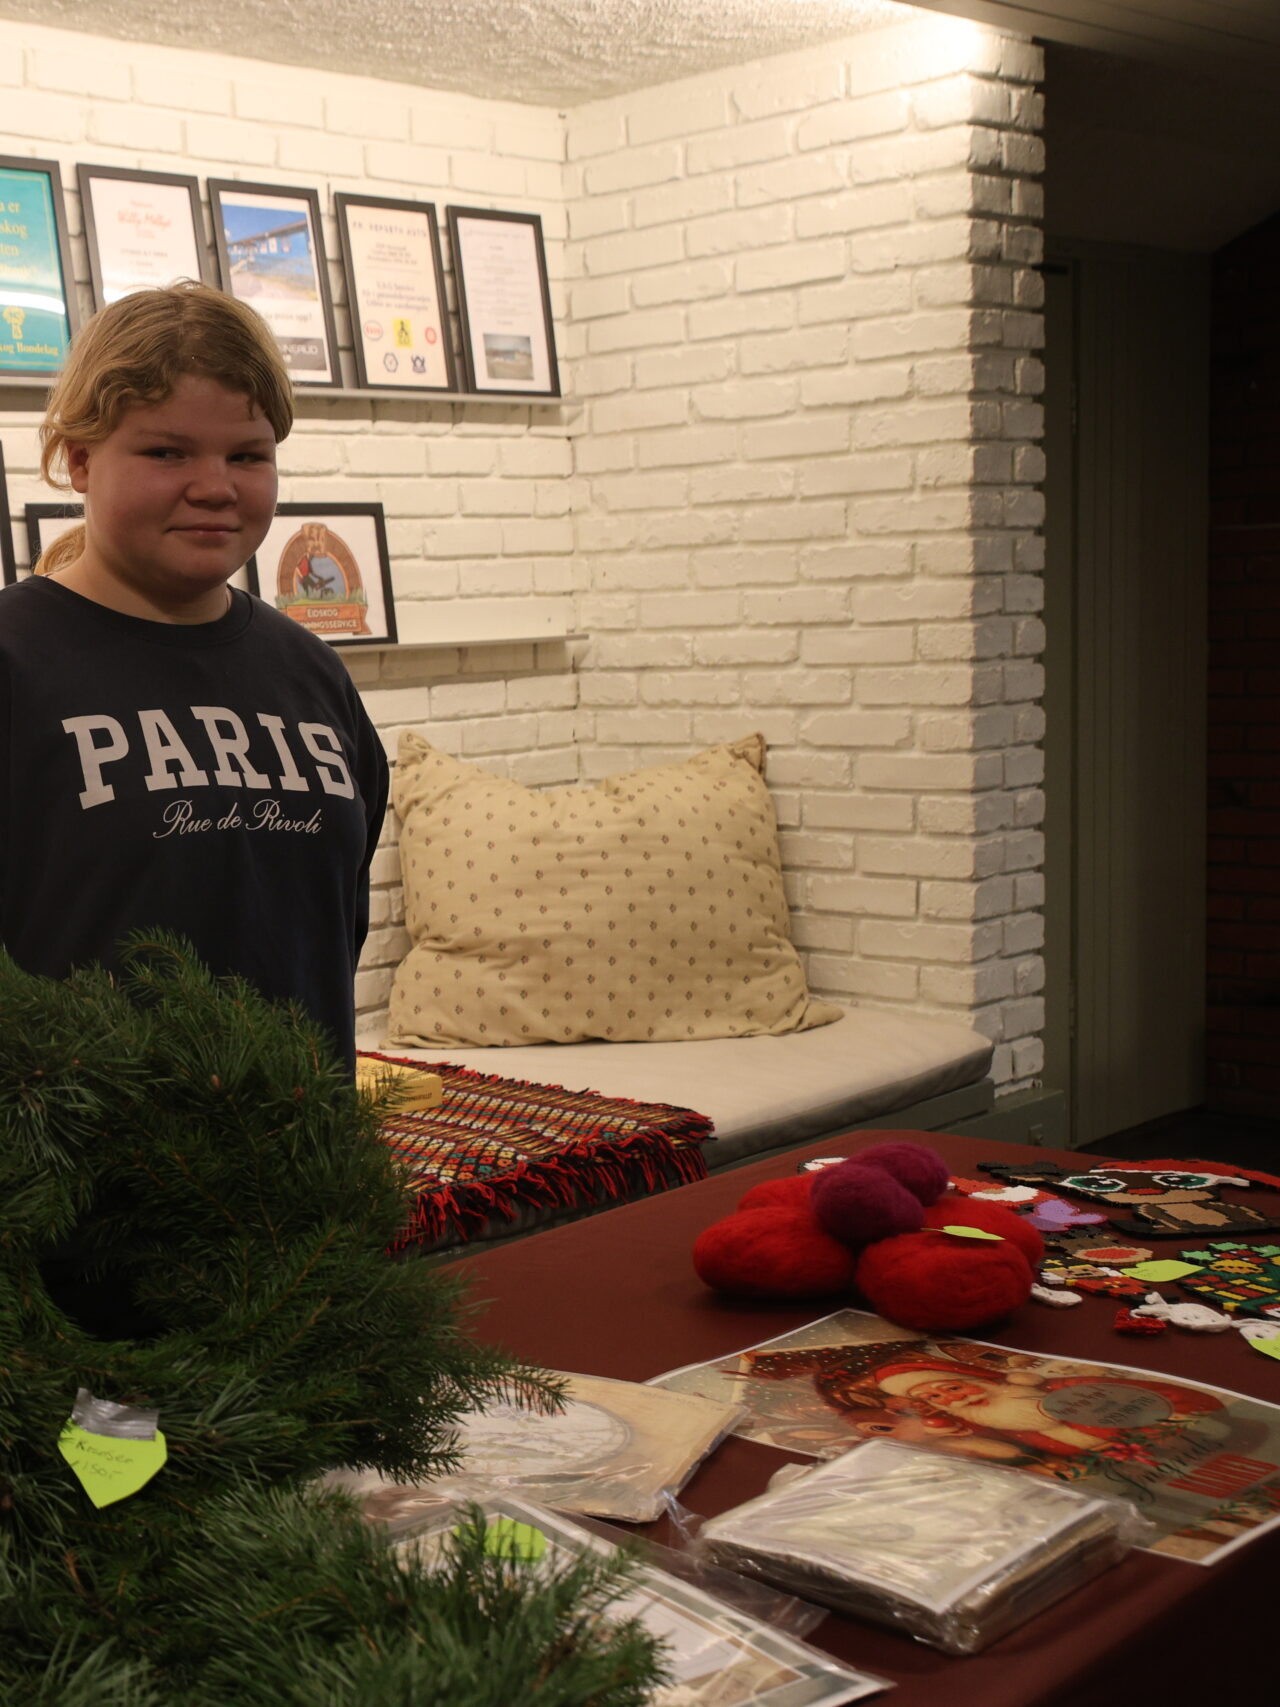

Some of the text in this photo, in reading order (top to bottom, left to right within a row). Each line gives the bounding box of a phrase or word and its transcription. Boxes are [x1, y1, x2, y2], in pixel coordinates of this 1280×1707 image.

[7, 201, 20, 214] er
[307, 608, 339, 618] EIDSKOG
[61, 706, 355, 810] PARIS
[153, 798, 322, 839] Rue de Rivoli
